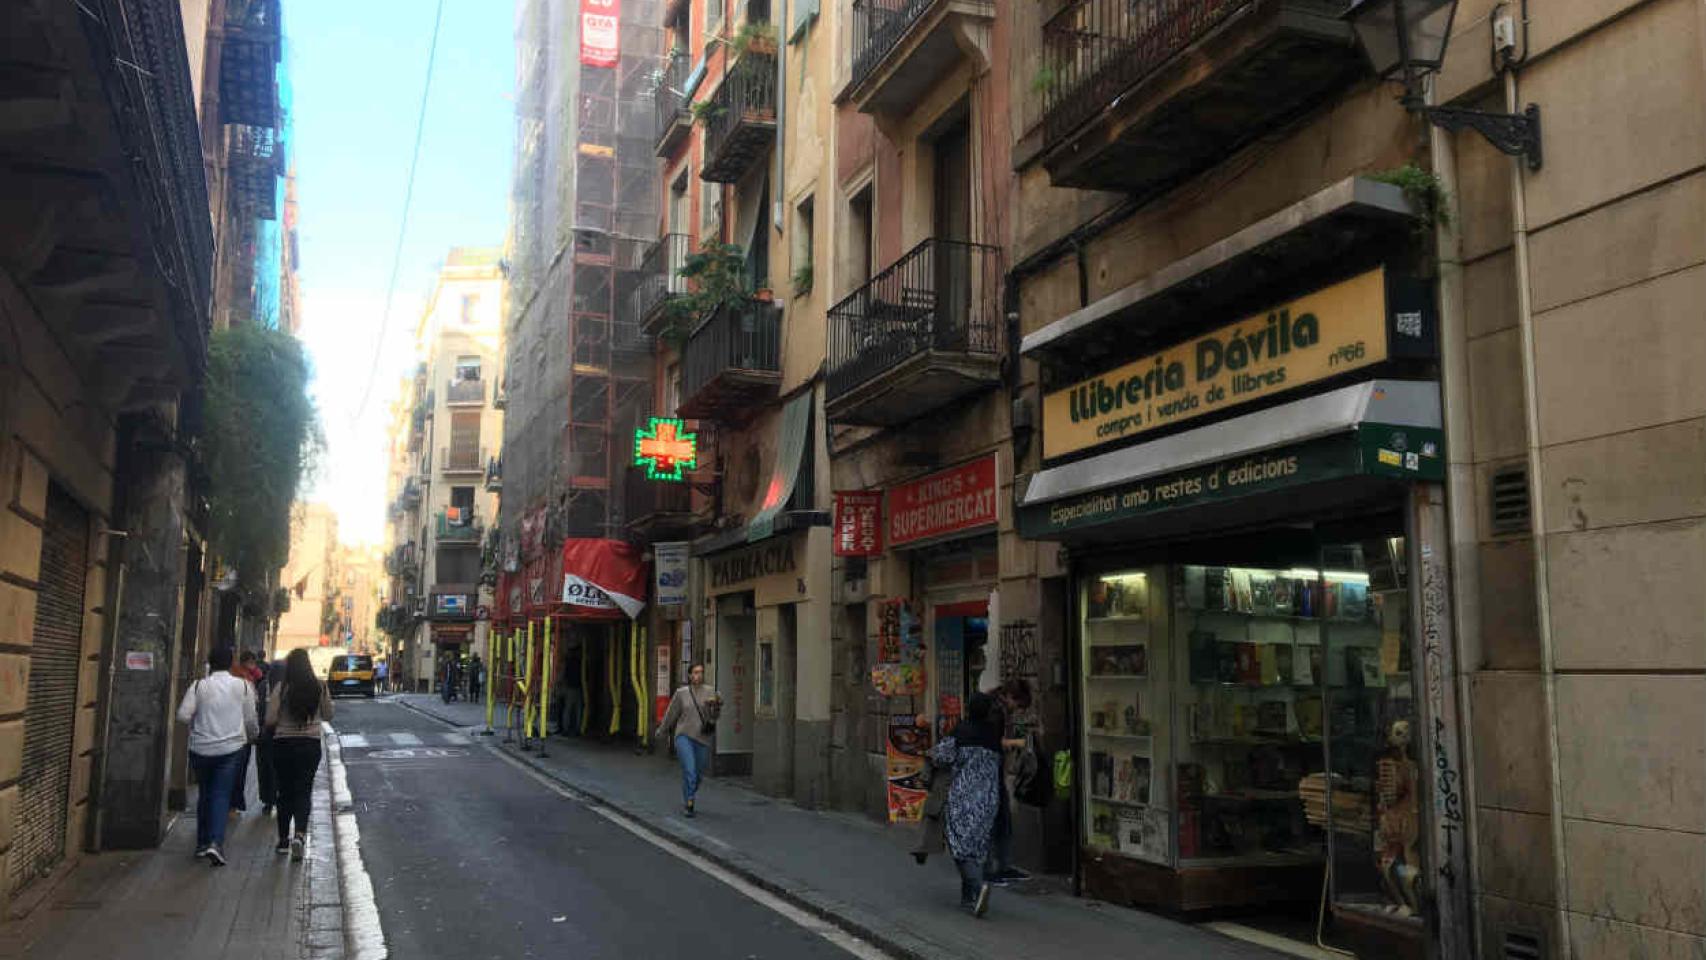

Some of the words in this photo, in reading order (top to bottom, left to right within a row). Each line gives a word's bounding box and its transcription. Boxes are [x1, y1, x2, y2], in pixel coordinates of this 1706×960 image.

[1196, 308, 1319, 382] Dávila
[1096, 412, 1142, 438] compra
[1147, 403, 1153, 422] i
[1157, 392, 1199, 418] venda
[1206, 382, 1226, 403] de
[1232, 366, 1287, 394] llibres
[893, 488, 992, 537] SUPERMERCAT
[1050, 495, 1118, 526] Especialitat
[1123, 486, 1149, 509] amb
[1155, 477, 1202, 502] restes
[1228, 455, 1298, 486] edicions
